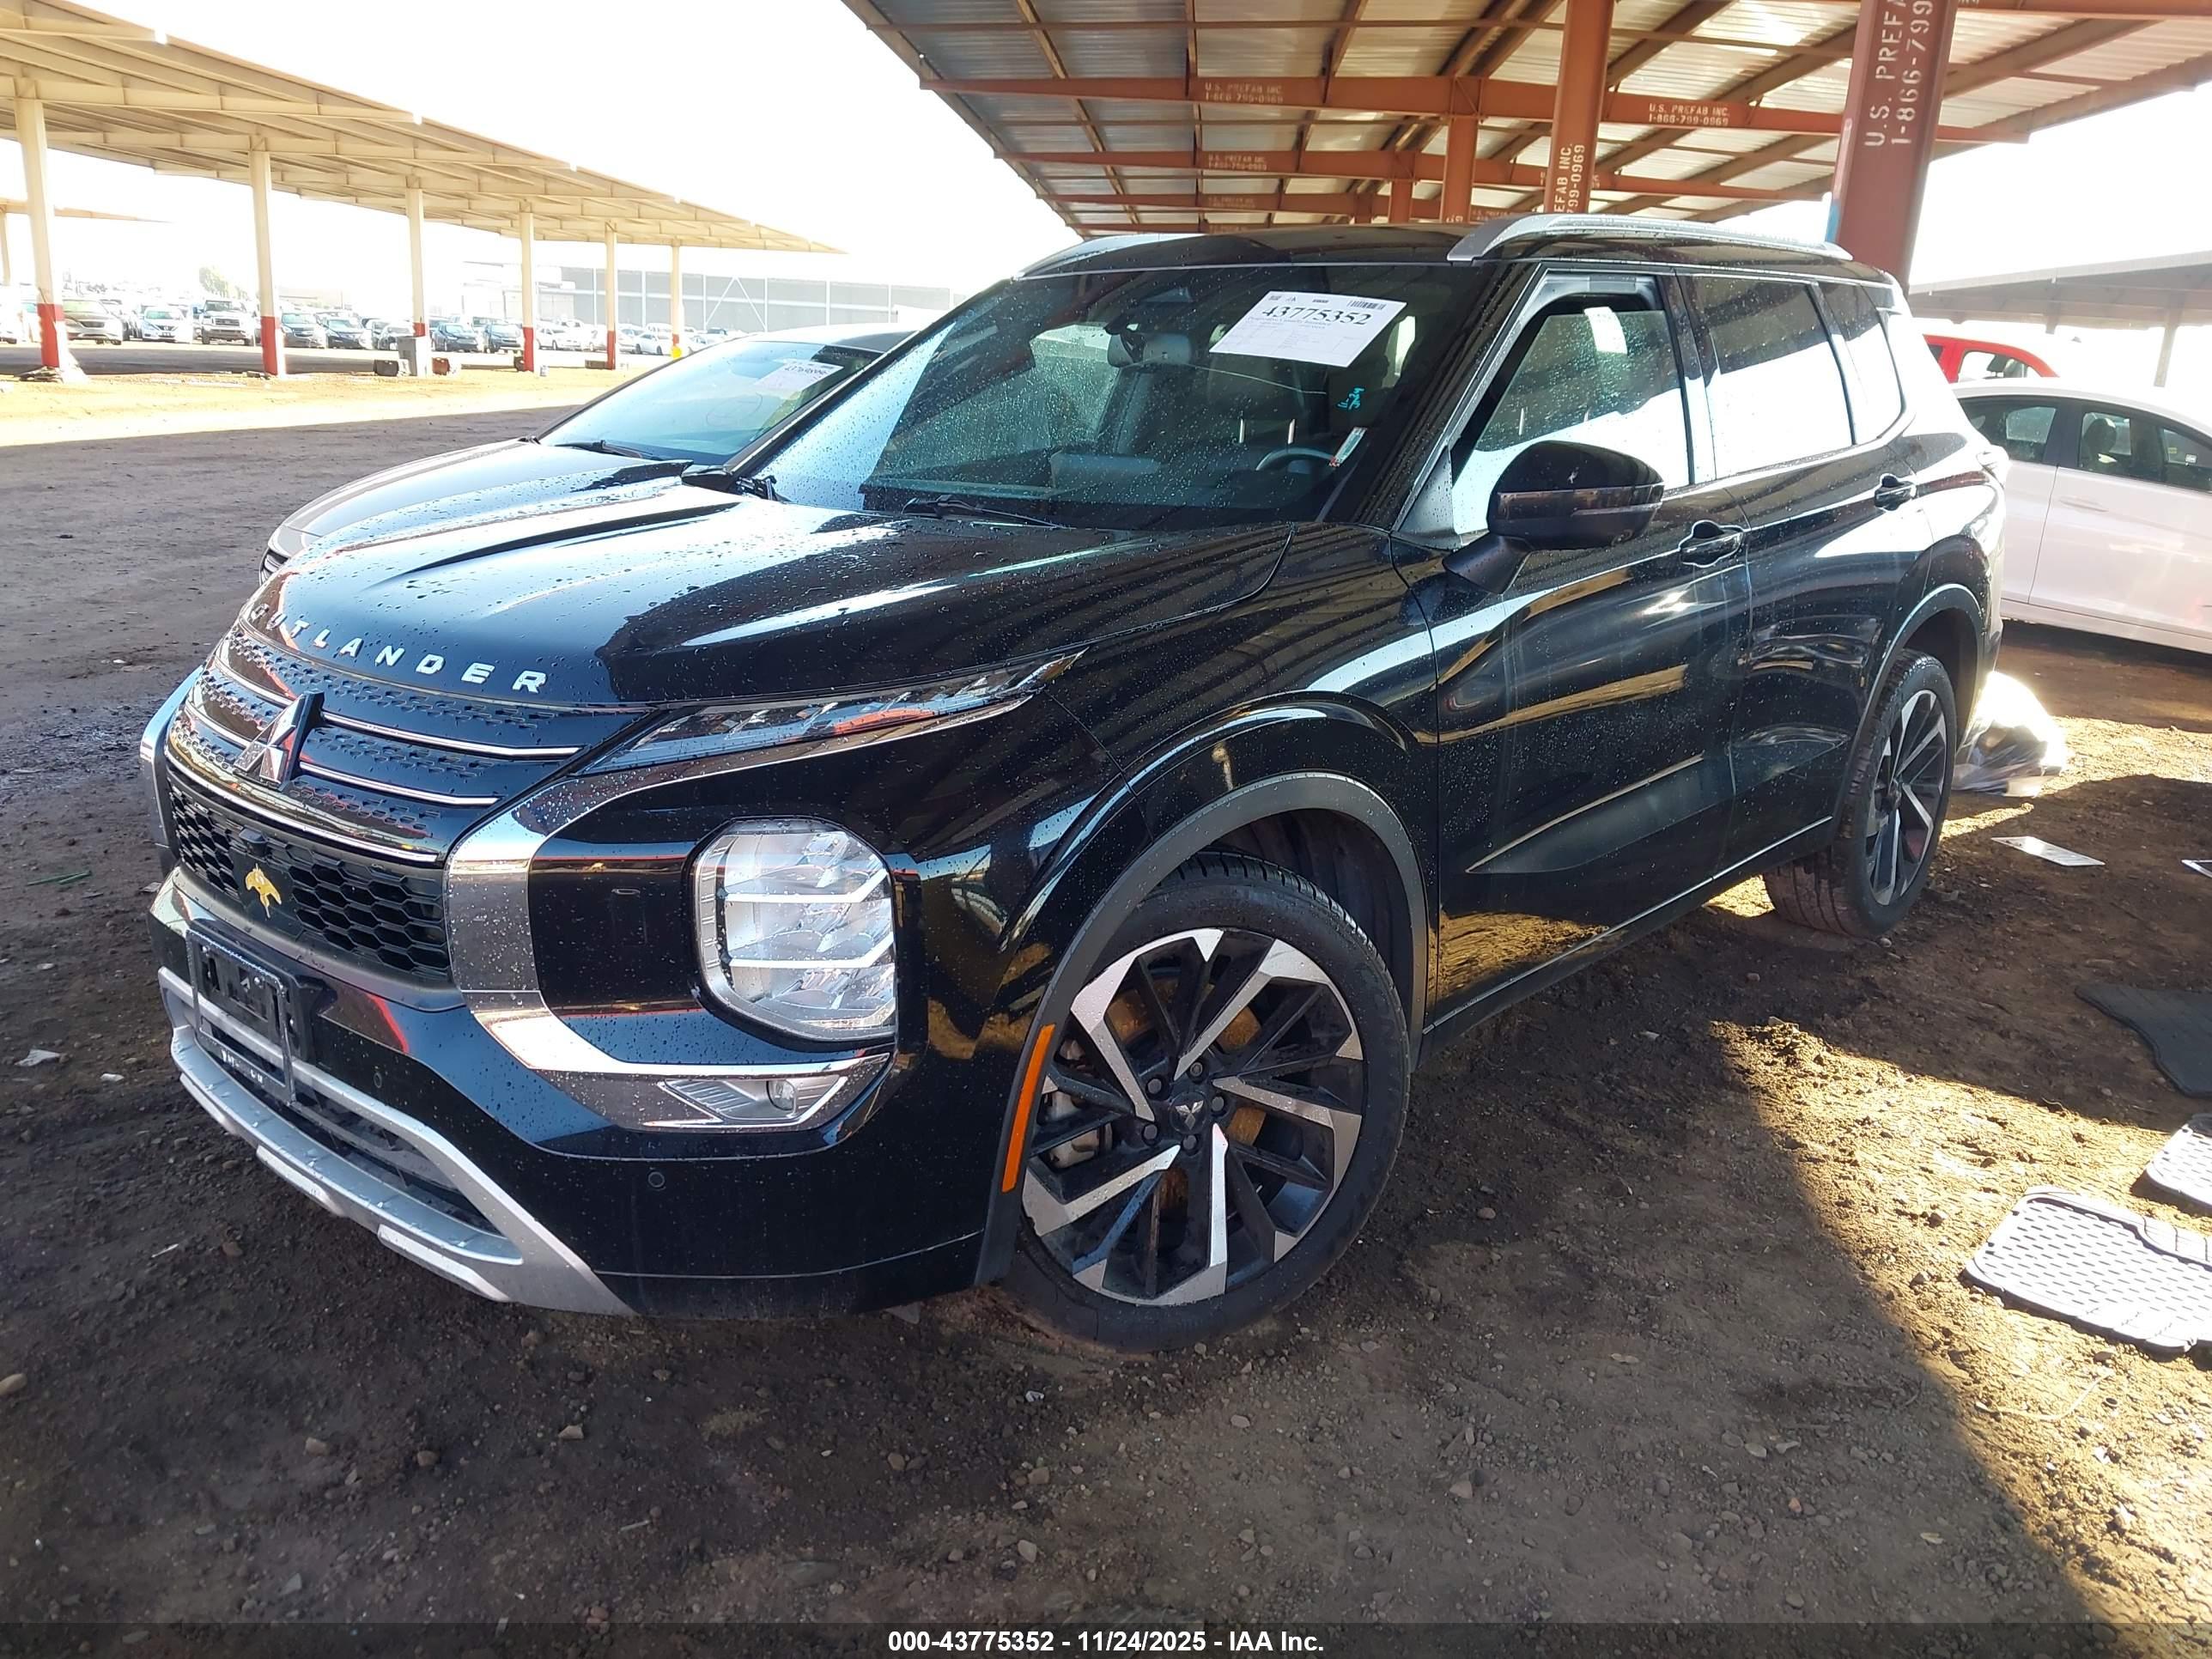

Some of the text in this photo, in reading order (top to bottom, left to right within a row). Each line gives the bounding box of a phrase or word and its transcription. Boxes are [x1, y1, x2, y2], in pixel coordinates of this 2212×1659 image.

[1671, 105, 1709, 115] PREFAB
[1864, 97, 1893, 146] U.S.
[1553, 177, 1569, 214] EFAB
[1261, 306, 1372, 325] 43775352
[252, 603, 548, 694] OUTLANDER
